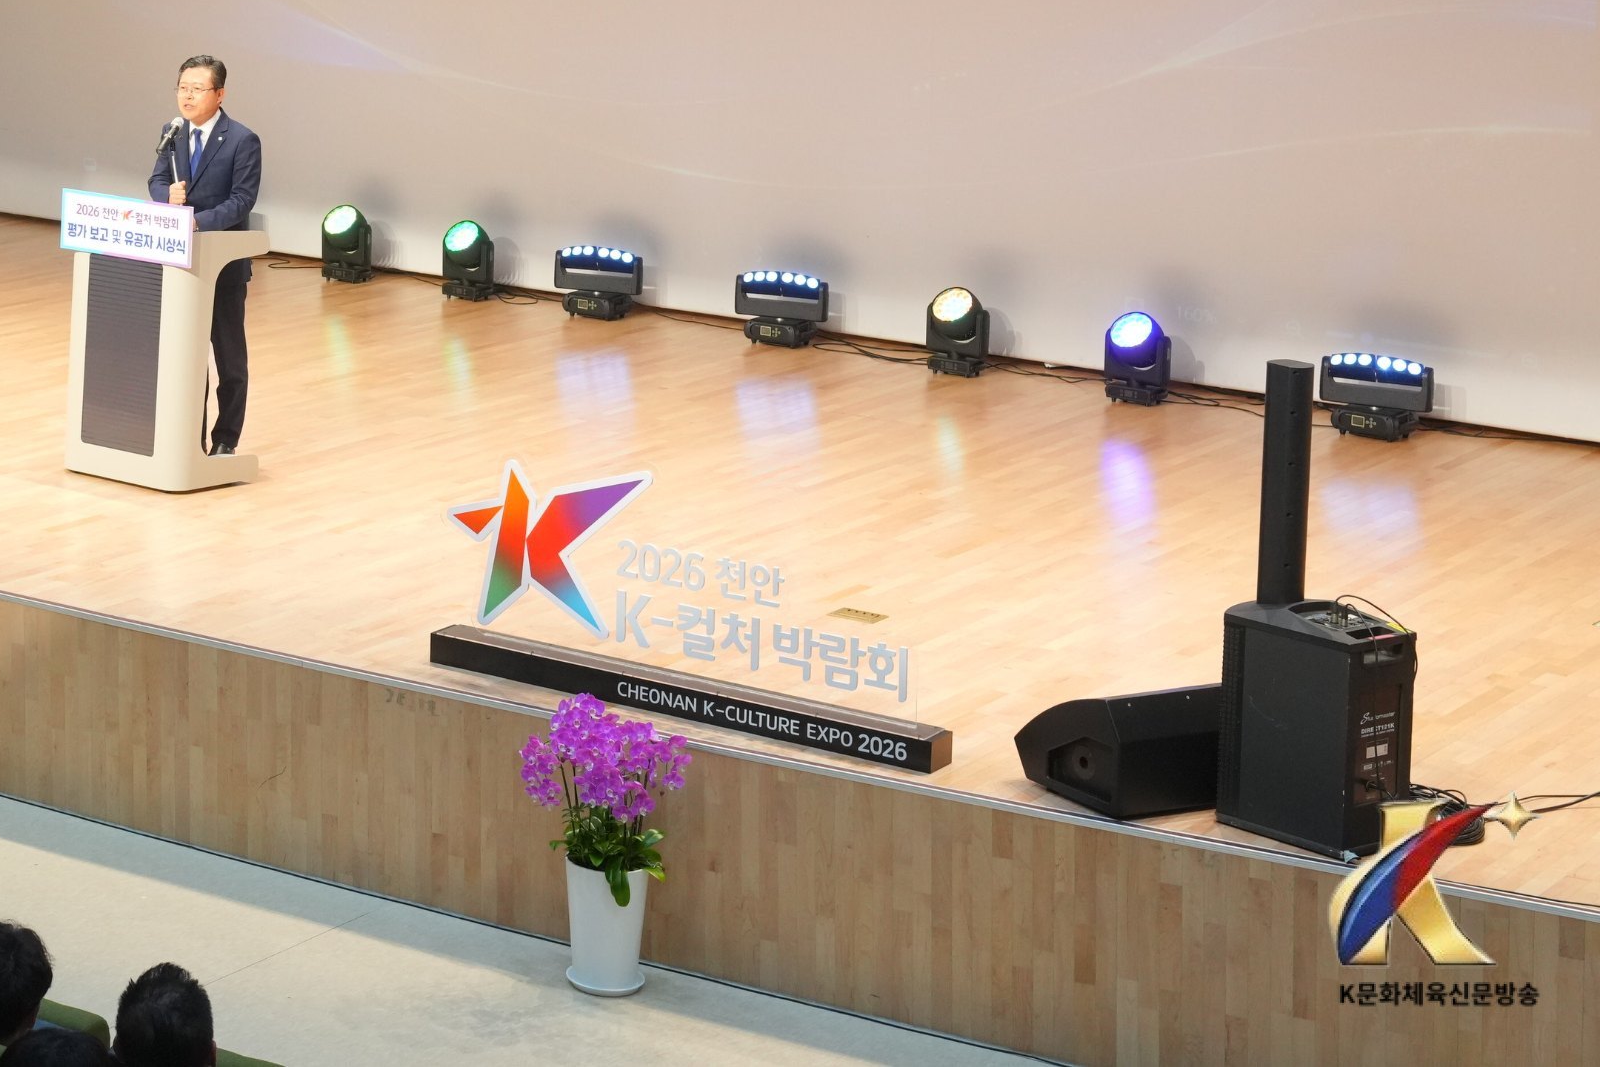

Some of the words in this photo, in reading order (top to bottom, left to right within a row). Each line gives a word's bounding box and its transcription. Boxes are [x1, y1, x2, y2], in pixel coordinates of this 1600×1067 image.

[67, 222, 87, 238] 평가
[90, 226, 109, 243] 보고
[112, 229, 121, 244] 및
[124, 230, 154, 250] 유공자
[156, 236, 186, 255] 시상식
[76, 203, 100, 218] 2026
[102, 207, 119, 221] 천안
[153, 215, 180, 231] 박람회
[616, 538, 707, 592] 2026
[715, 556, 786, 608] 천안
[615, 589, 761, 672] K-컬처
[772, 623, 910, 703] 박람회
[617, 682, 698, 714] CHEONAN
[703, 700, 801, 736] K-CULTURE
[806, 722, 854, 748] EXPO
[857, 733, 908, 762] 2026
